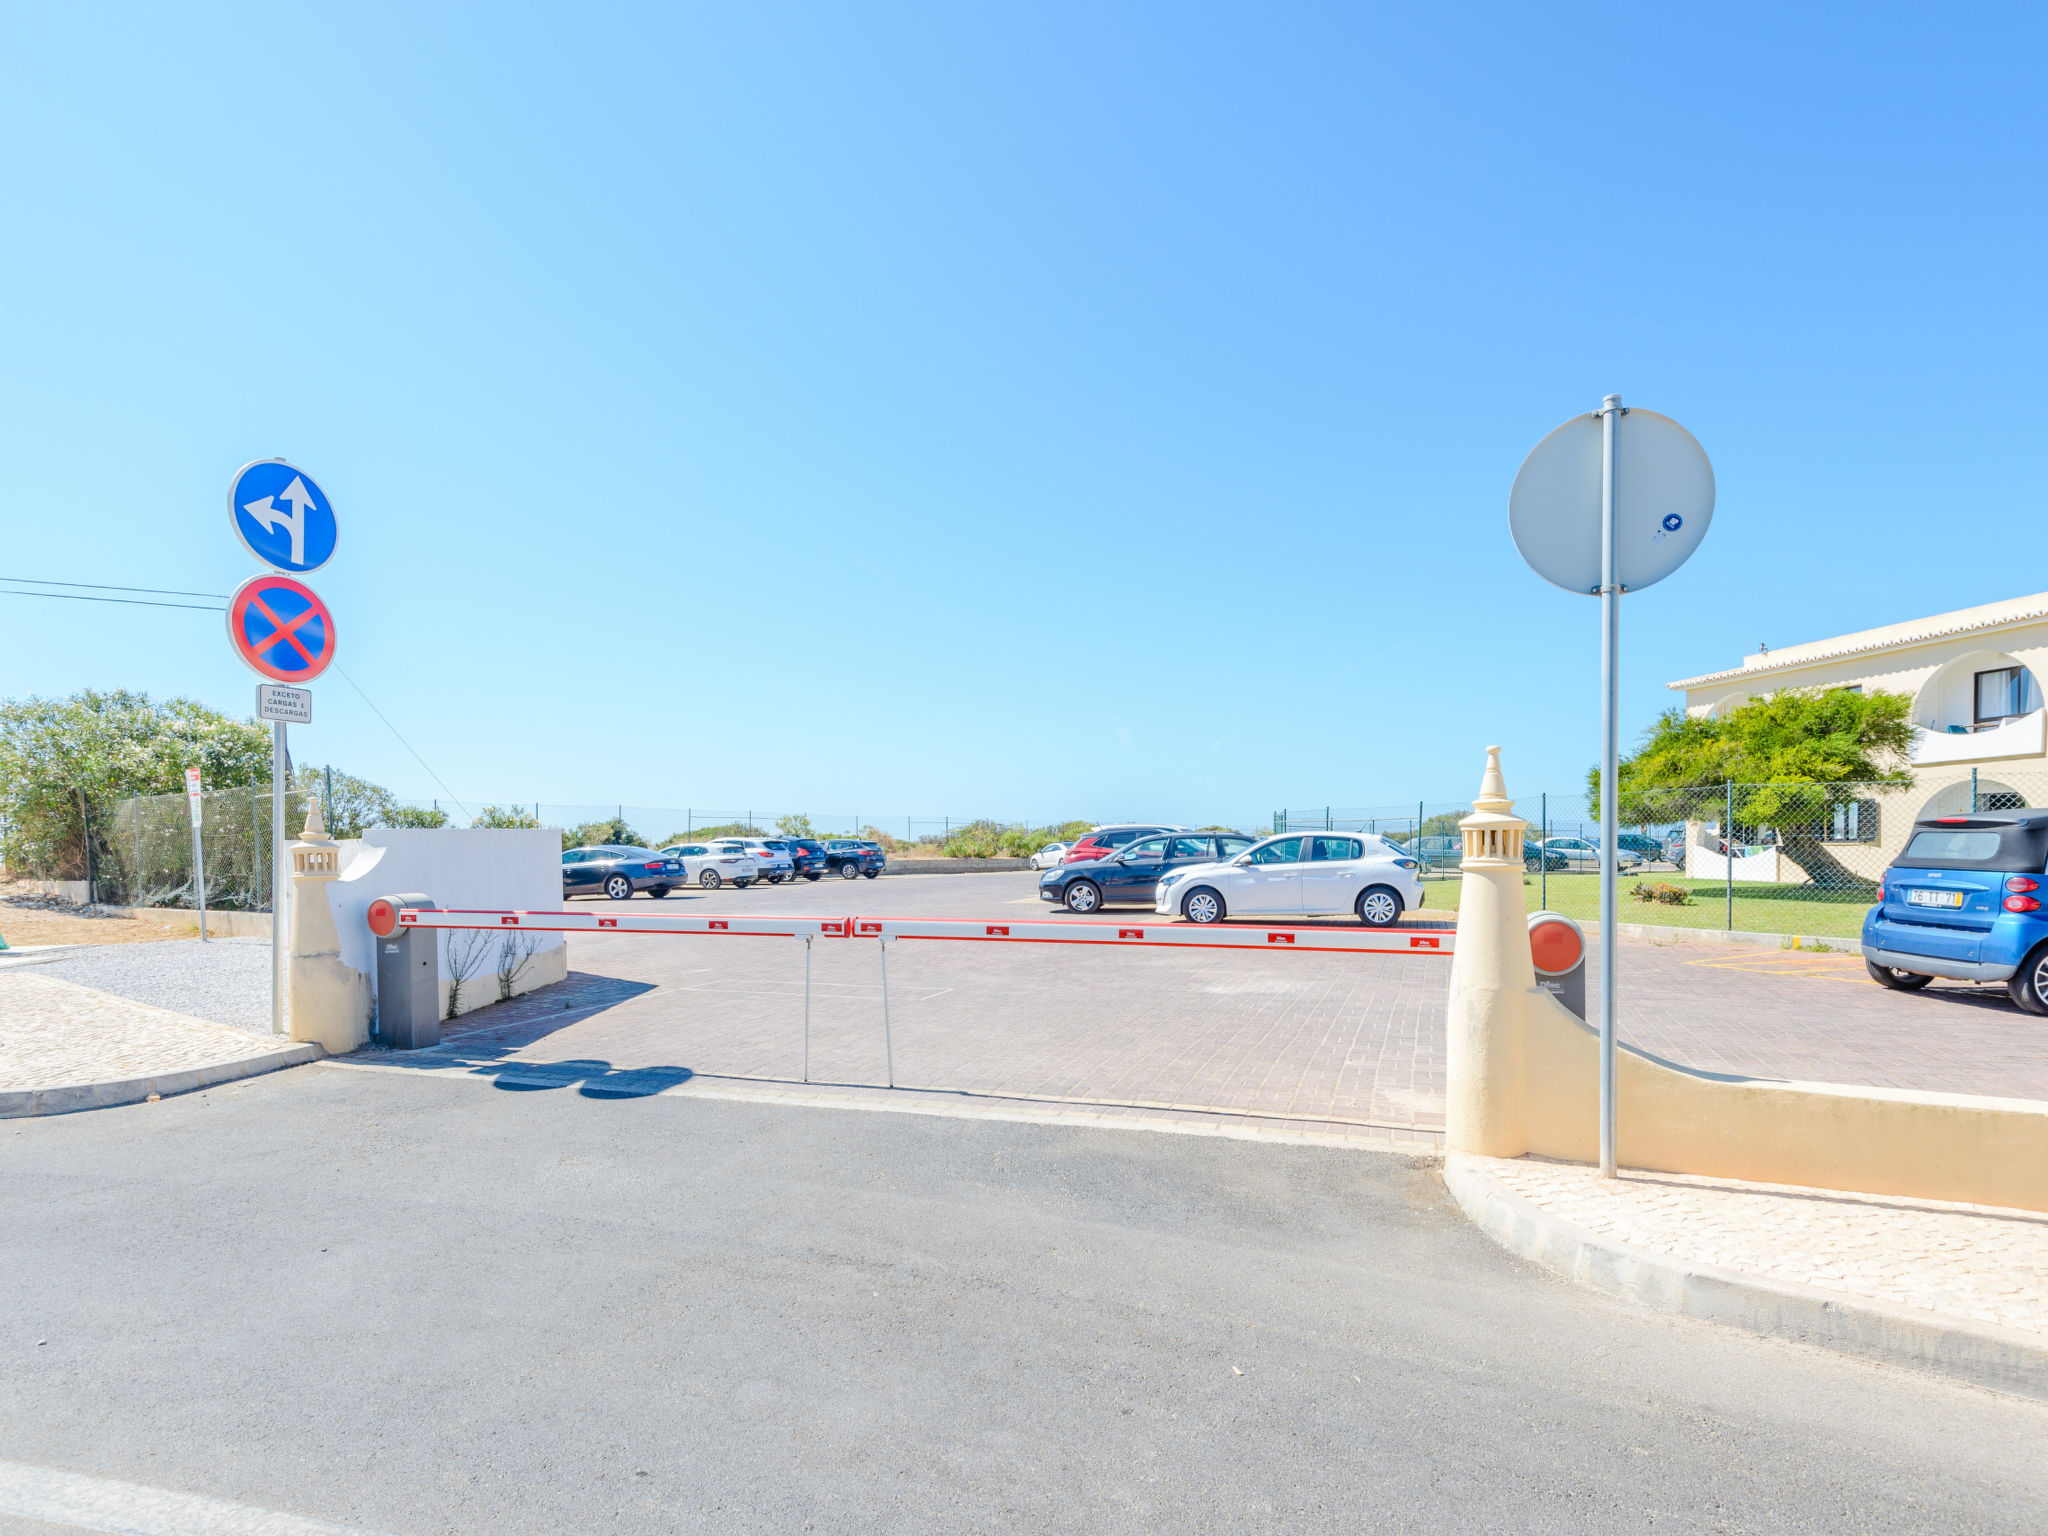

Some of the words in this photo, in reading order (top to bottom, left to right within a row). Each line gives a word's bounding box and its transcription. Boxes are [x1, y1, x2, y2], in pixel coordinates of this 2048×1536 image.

[272, 690, 301, 699] EXCETO
[267, 698, 298, 708] CARGAS
[264, 706, 308, 717] DESCARGAS
